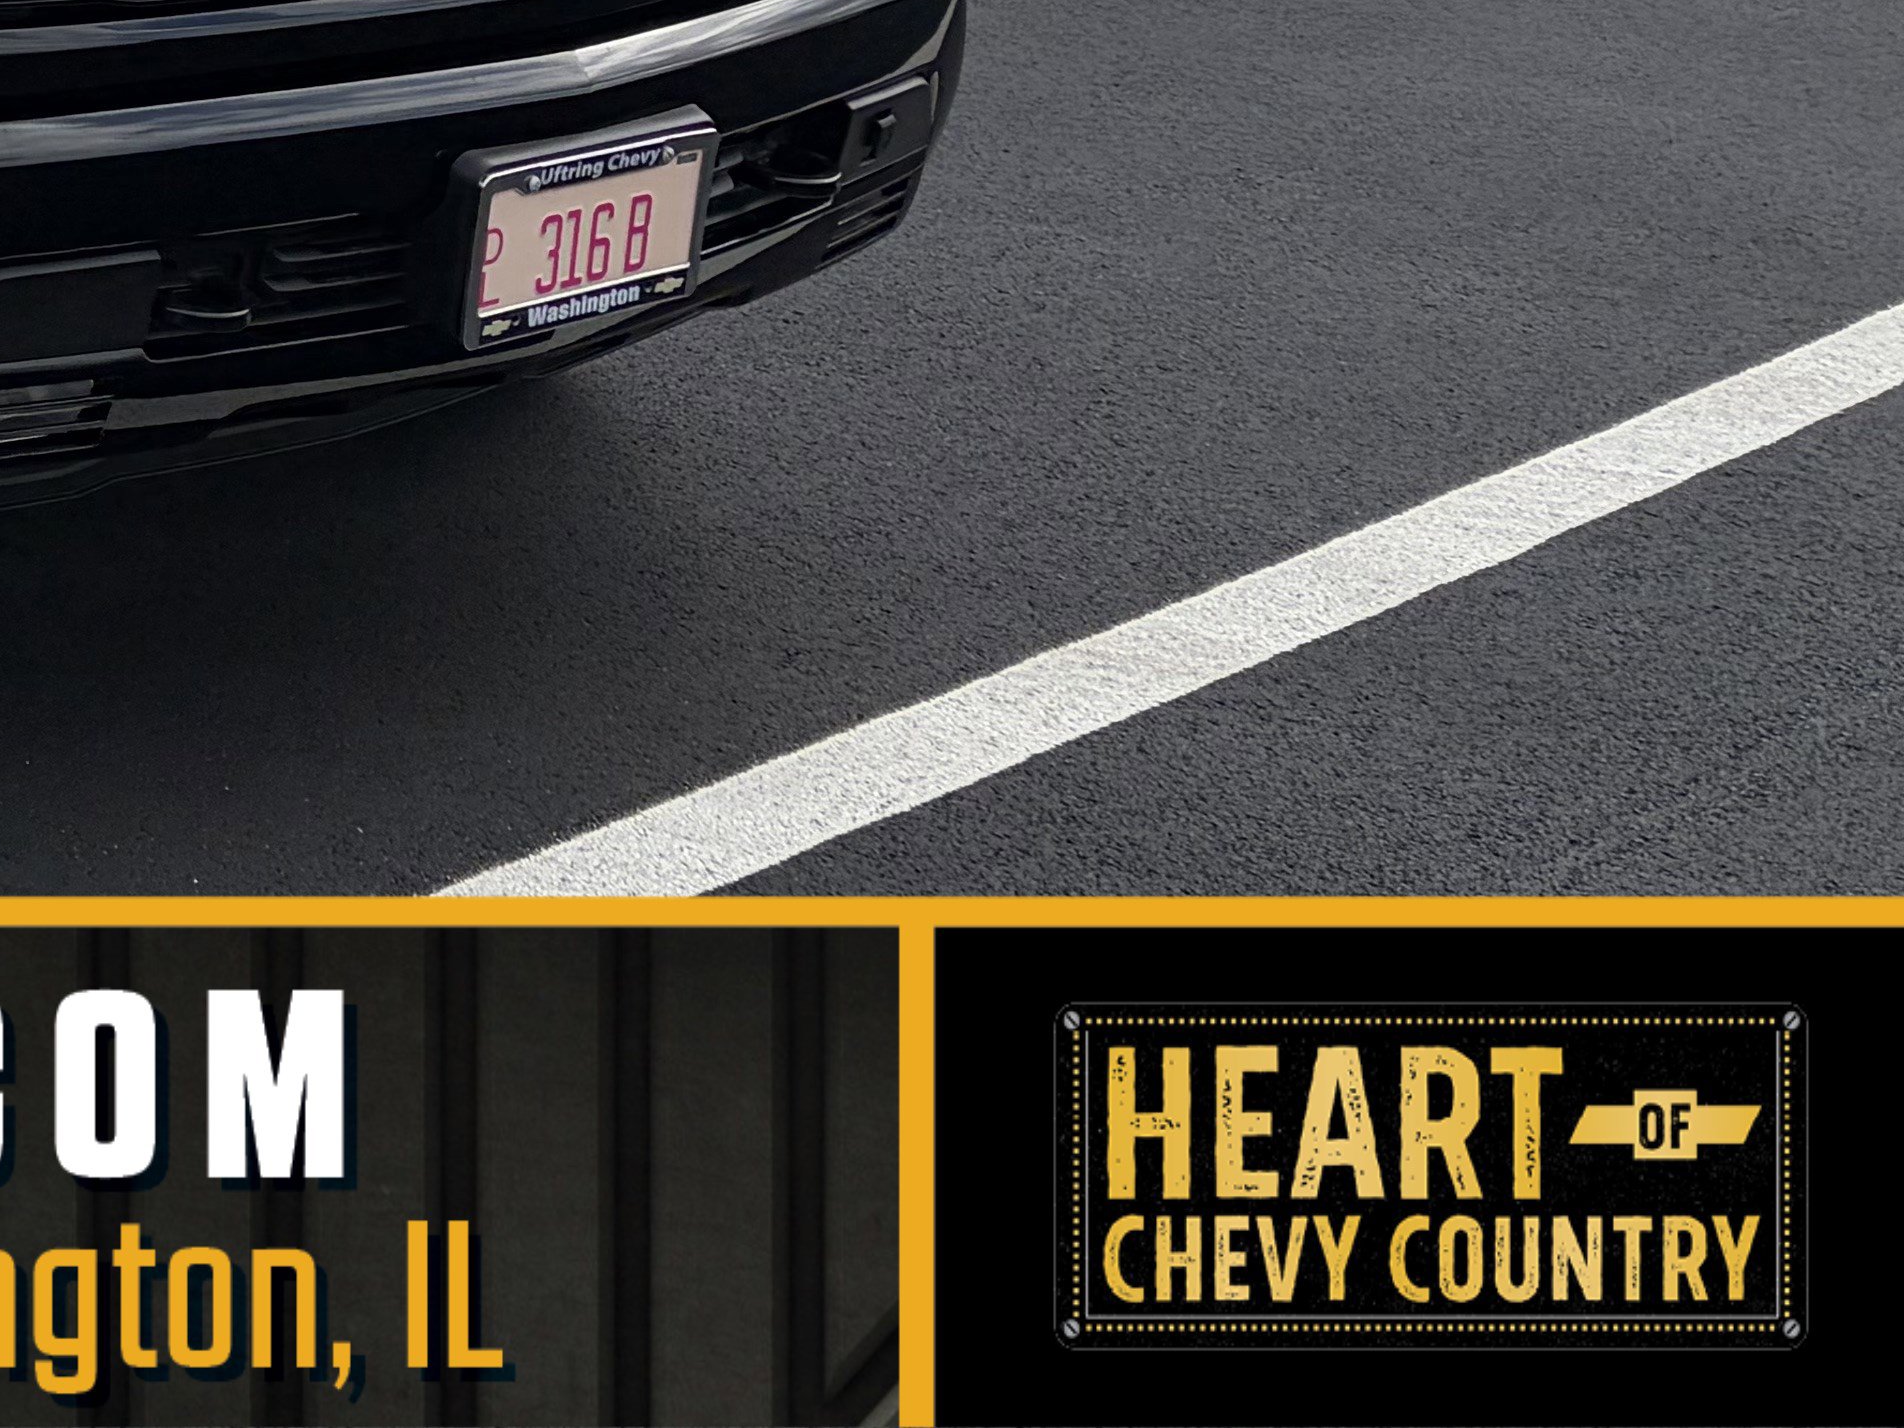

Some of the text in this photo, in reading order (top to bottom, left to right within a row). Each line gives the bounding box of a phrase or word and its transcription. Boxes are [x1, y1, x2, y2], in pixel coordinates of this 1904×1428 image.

[541, 159, 604, 186] Uftring
[607, 147, 662, 171] Chevy
[535, 203, 615, 294] 316
[528, 284, 641, 327] Washington
